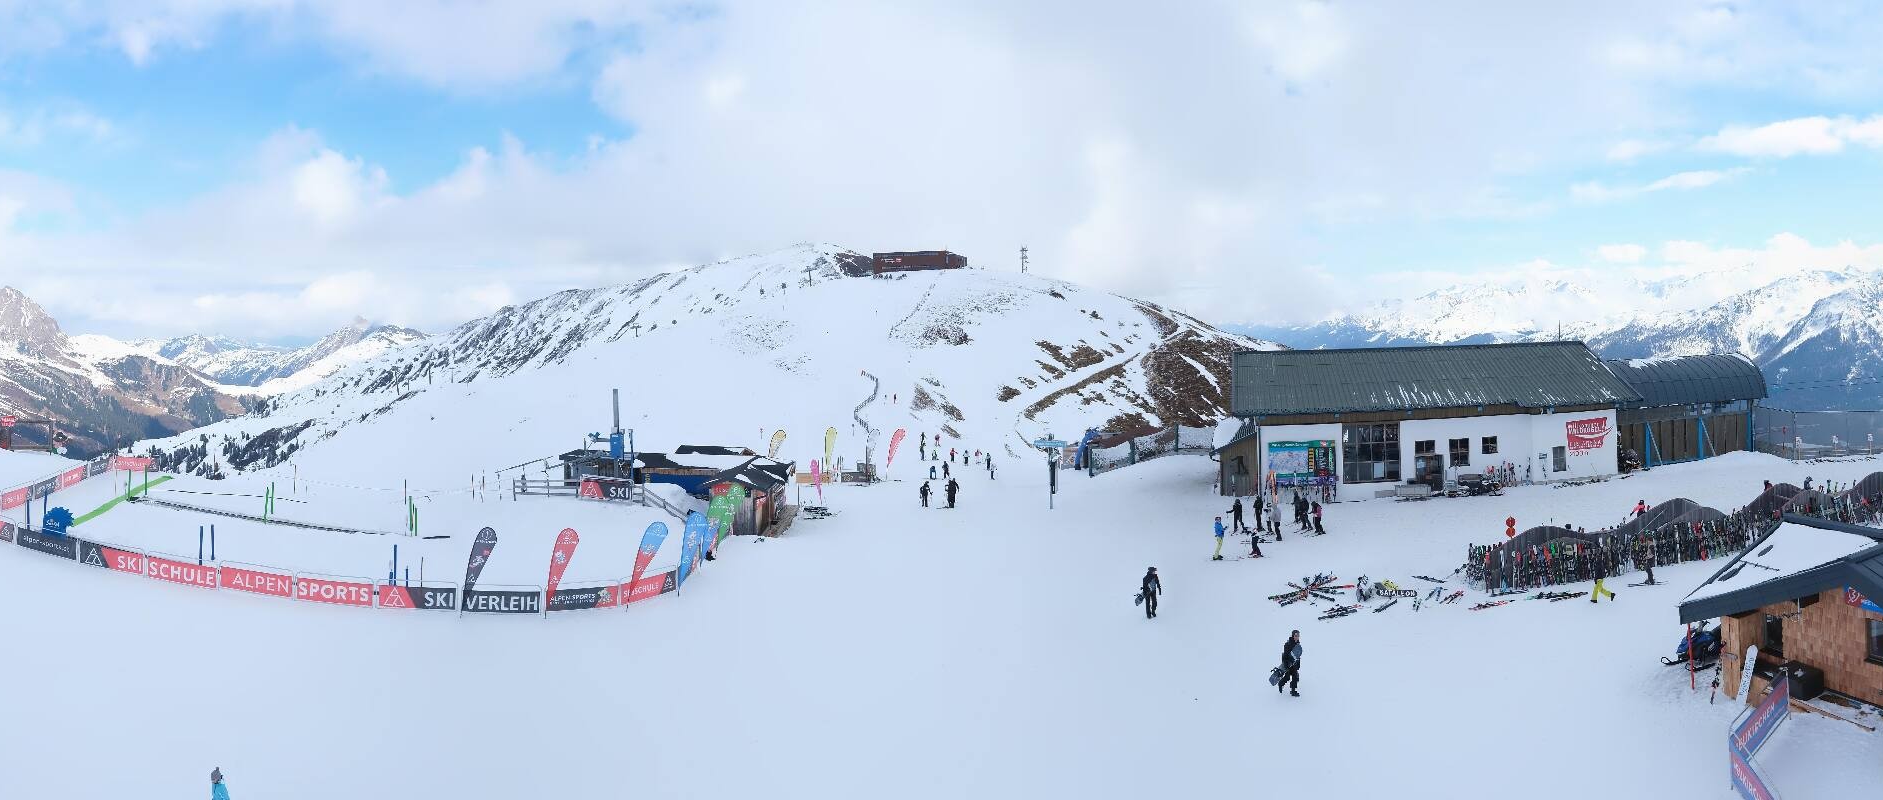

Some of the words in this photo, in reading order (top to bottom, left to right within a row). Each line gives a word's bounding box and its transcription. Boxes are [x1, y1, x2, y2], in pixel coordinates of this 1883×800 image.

[609, 488, 629, 498] SKI
[118, 556, 142, 572] SKI
[149, 562, 215, 586] SCHULE
[232, 572, 289, 594] ALPEN
[298, 582, 369, 602] SPORTS
[424, 591, 454, 607] SKI
[466, 594, 538, 611] VERLEIH
